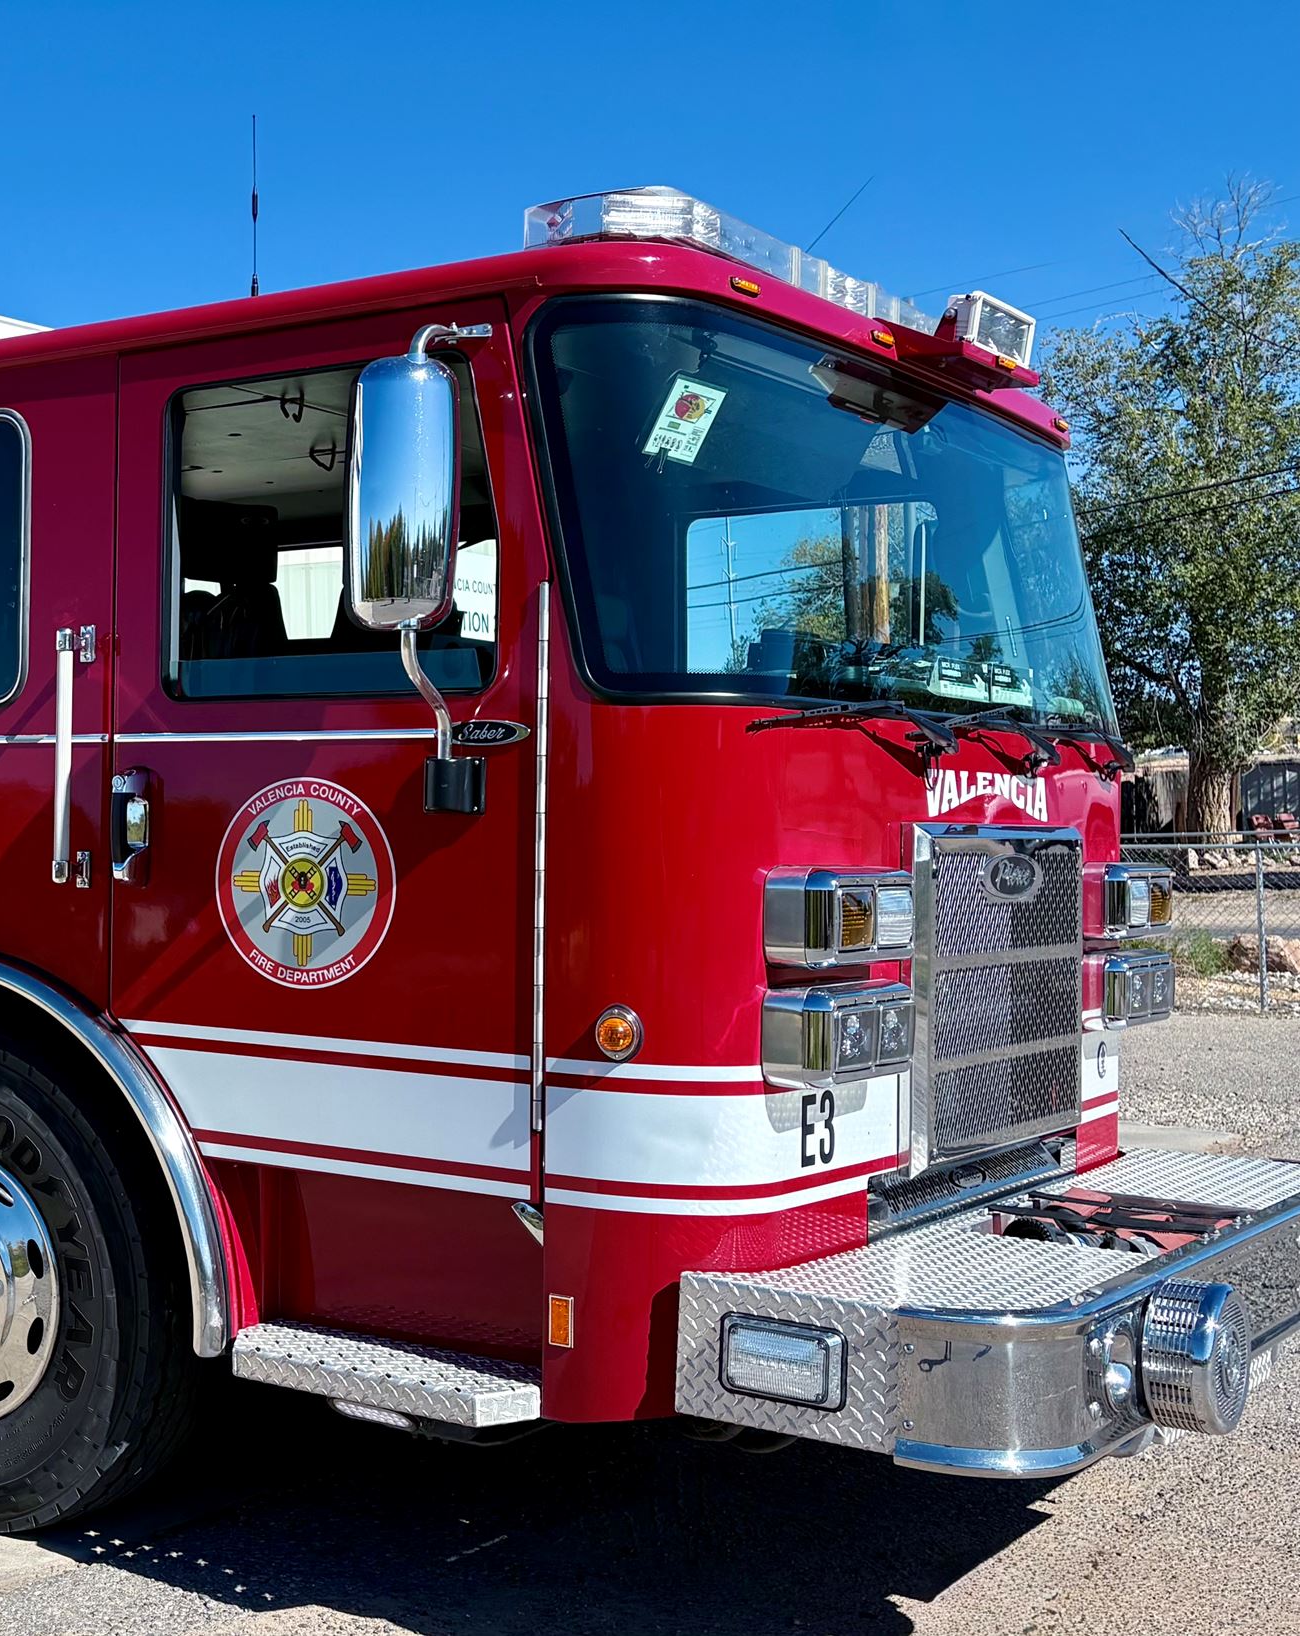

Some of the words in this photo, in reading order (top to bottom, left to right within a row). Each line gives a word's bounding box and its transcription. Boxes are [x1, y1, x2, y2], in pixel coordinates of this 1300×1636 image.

[458, 723, 507, 742] Saber
[248, 783, 305, 817] VALENCIA
[309, 783, 362, 817] COUNTY
[924, 768, 1049, 823] VALENCIA
[285, 841, 321, 853] Established
[294, 915, 312, 925] 2005
[249, 948, 274, 974] FIRE
[277, 953, 357, 983] DEPARTMENT
[801, 1089, 835, 1168] E3
